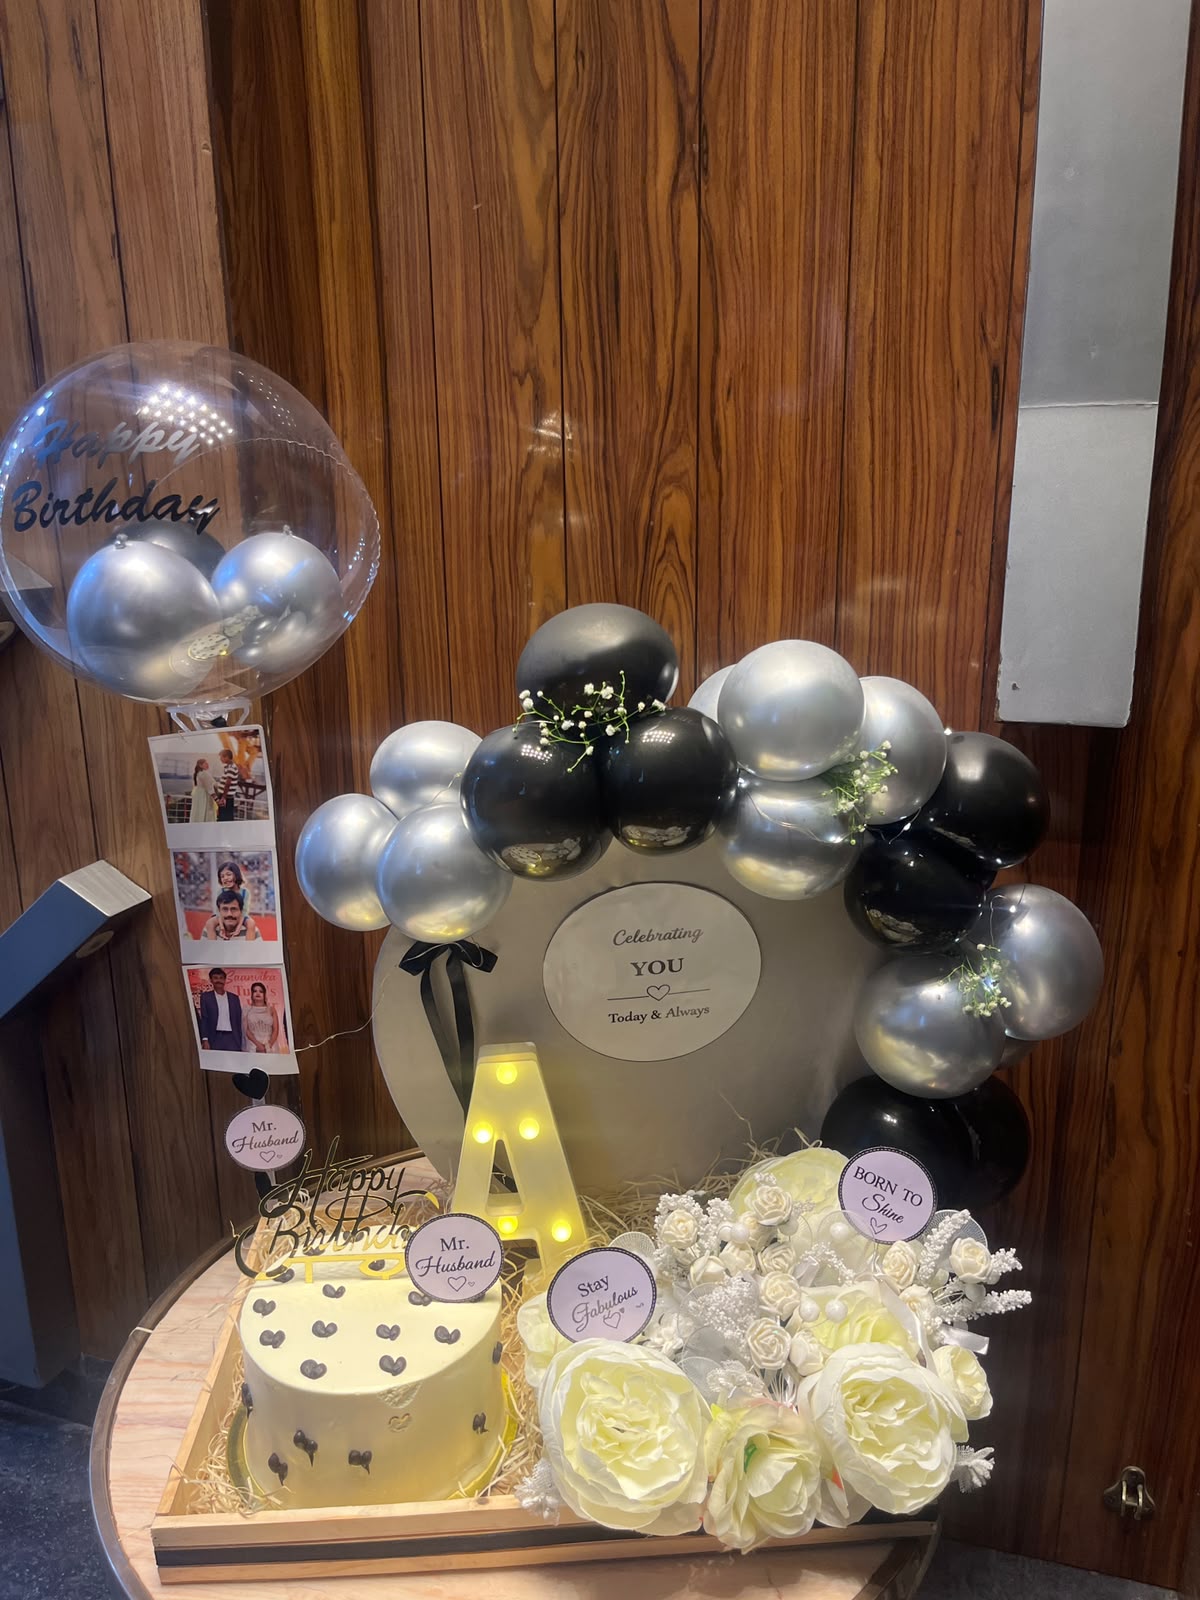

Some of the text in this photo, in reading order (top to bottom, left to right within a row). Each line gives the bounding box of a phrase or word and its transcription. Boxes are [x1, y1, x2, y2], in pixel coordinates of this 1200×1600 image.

[32, 419, 200, 469] Happy
[12, 477, 220, 535] Birthday
[613, 927, 704, 946] Celebrating
[630, 958, 684, 976] YOU
[608, 1006, 710, 1024] Today & Always
[251, 1121, 277, 1133] Mr.
[231, 1130, 300, 1154] Husband
[258, 1135, 438, 1231] Happy
[853, 1166, 923, 1207] BORN TO
[861, 1193, 905, 1224] Shine
[440, 1236, 470, 1252] Mr.
[415, 1250, 496, 1277] Husband
[577, 1275, 609, 1298] Stay
[571, 1286, 639, 1333] Fabulous
